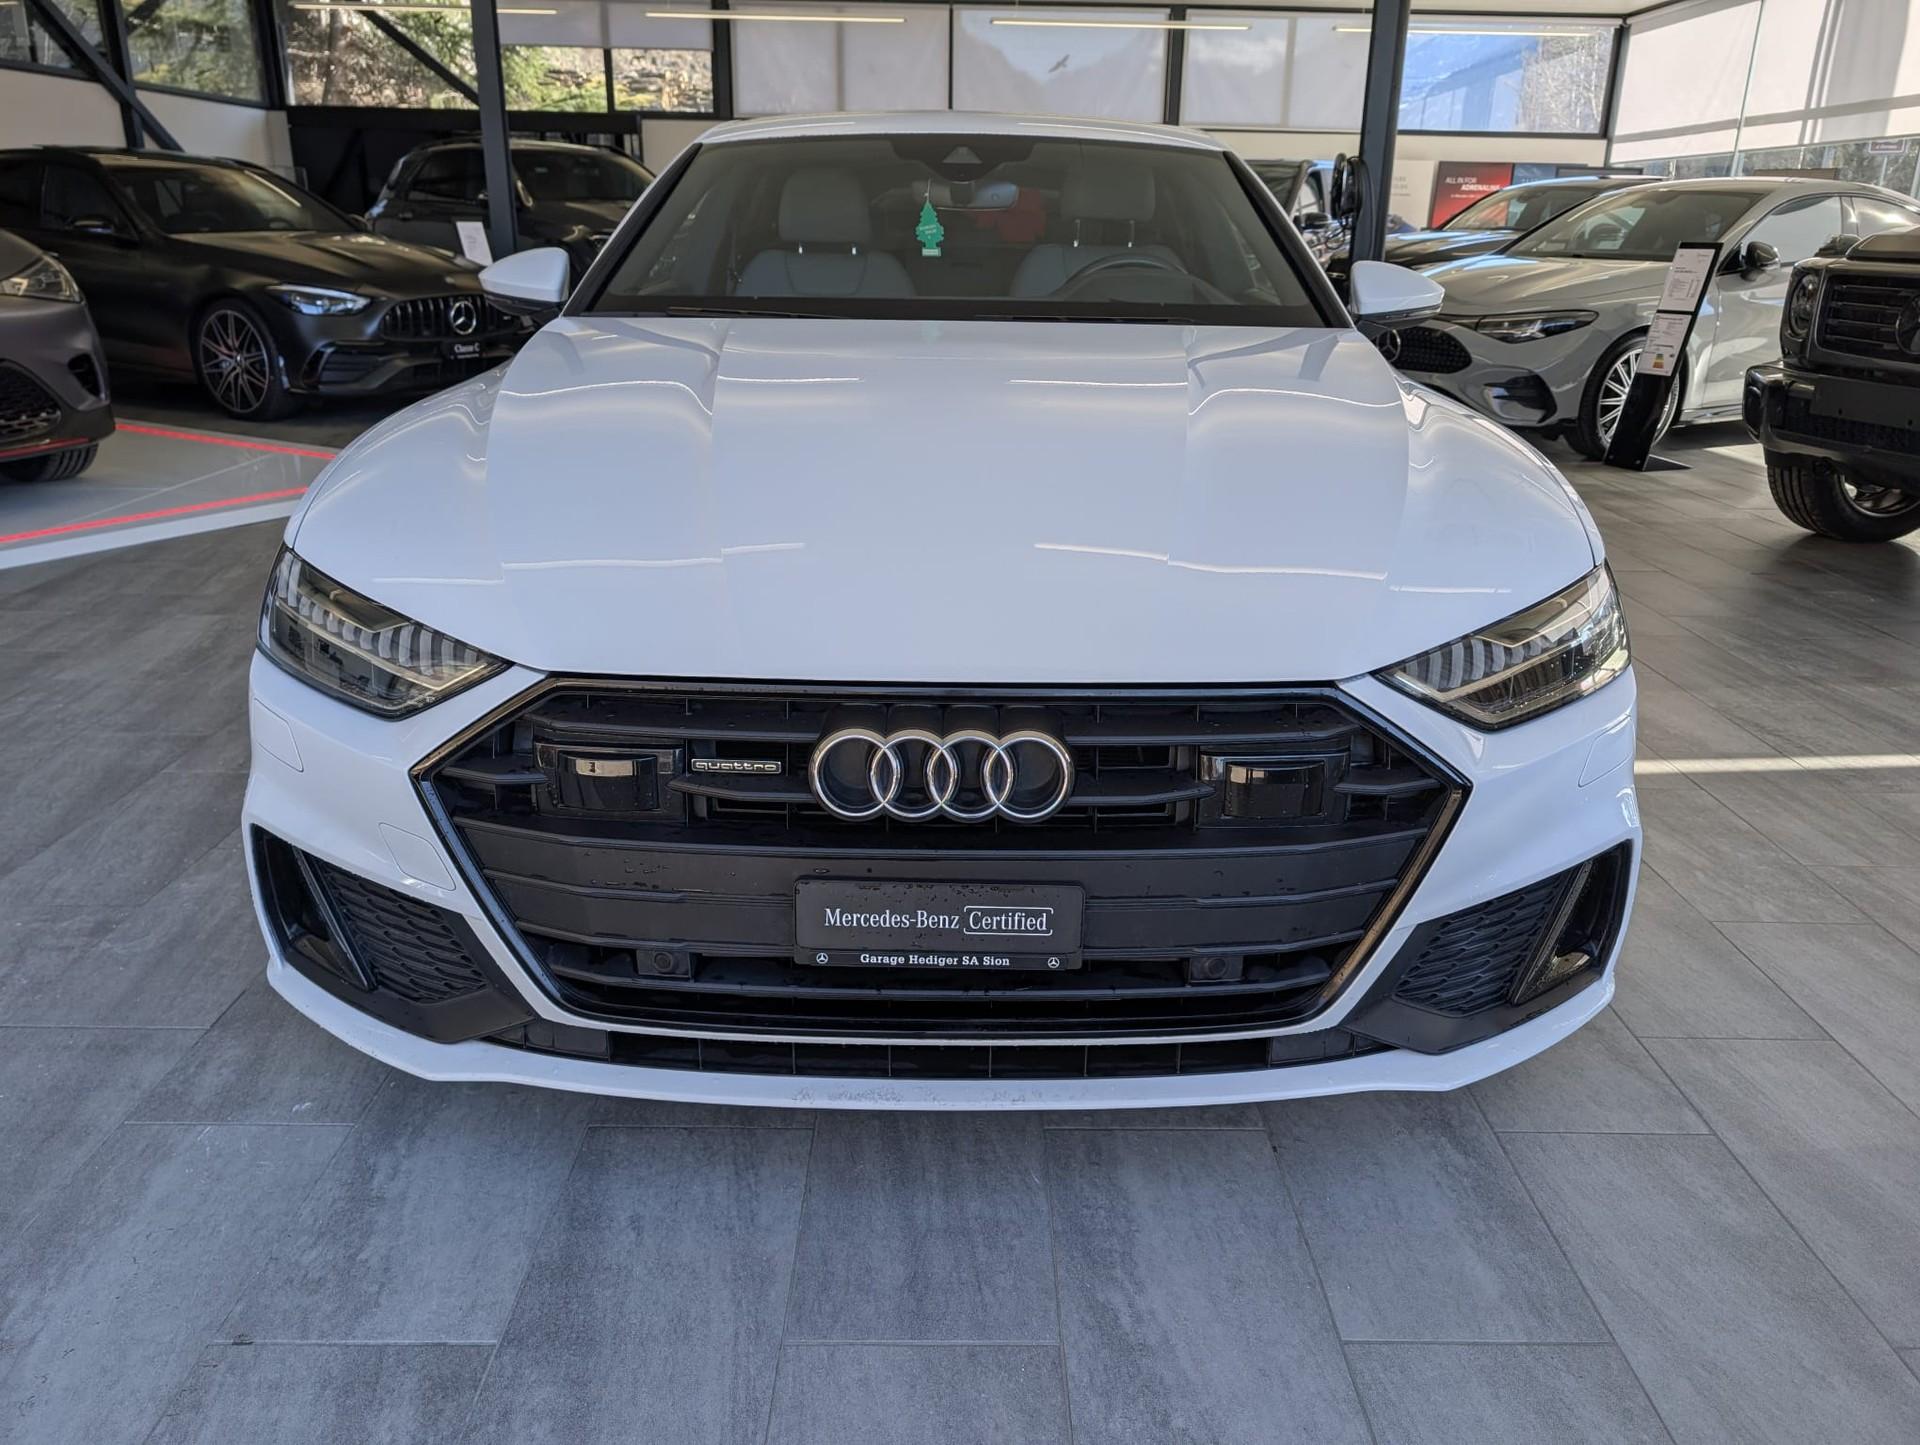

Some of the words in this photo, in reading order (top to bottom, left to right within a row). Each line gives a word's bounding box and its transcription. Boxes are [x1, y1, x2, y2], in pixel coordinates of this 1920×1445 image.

[695, 762, 777, 771] quattro
[824, 908, 960, 930] Mercedes-Benz
[968, 911, 1047, 931] Certified
[860, 953, 905, 965] Garage
[908, 955, 959, 966] Hediger
[962, 956, 979, 966] SA
[983, 956, 1010, 966] Sion
